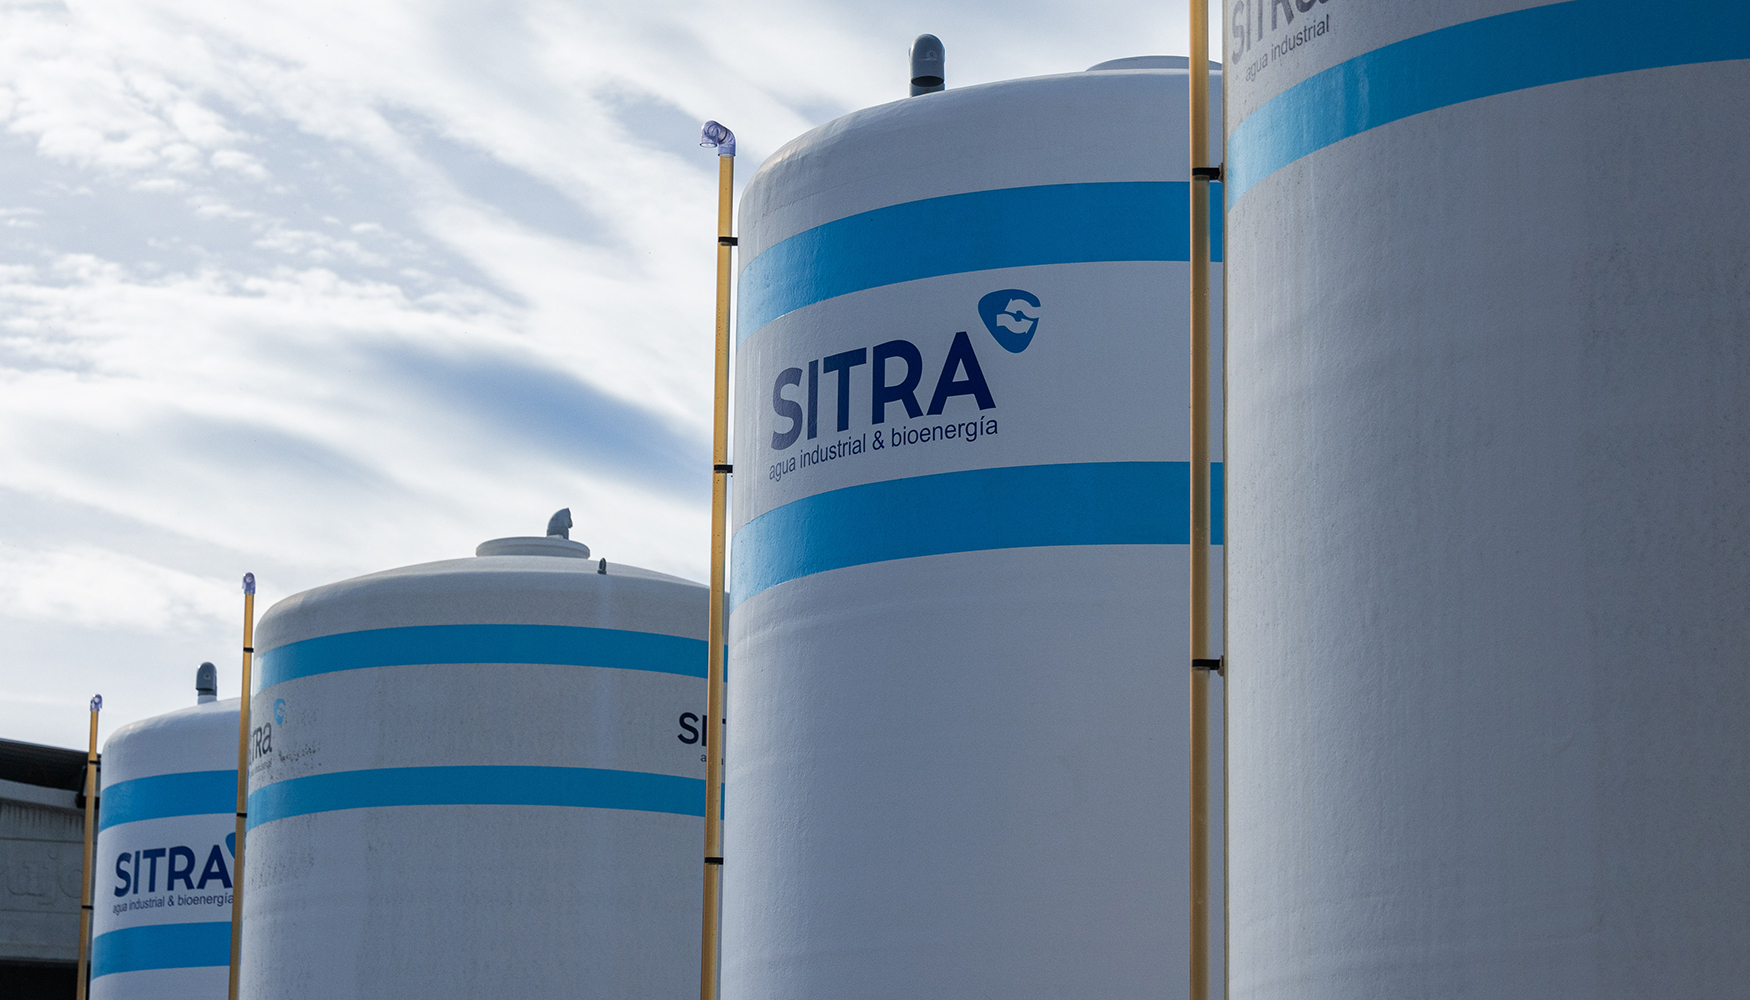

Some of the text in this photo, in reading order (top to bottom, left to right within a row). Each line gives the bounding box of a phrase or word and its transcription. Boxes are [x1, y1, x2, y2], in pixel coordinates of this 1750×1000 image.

[1232, 0, 1330, 65] SITR
[1246, 14, 1330, 82] agua industrial
[771, 331, 996, 450] SITRA
[769, 415, 998, 482] agua industrial & bioenergía
[678, 712, 726, 747] SI
[114, 844, 233, 897] SITRA
[113, 903, 127, 916] agua
[129, 896, 165, 910] industrial
[167, 895, 174, 907] &
